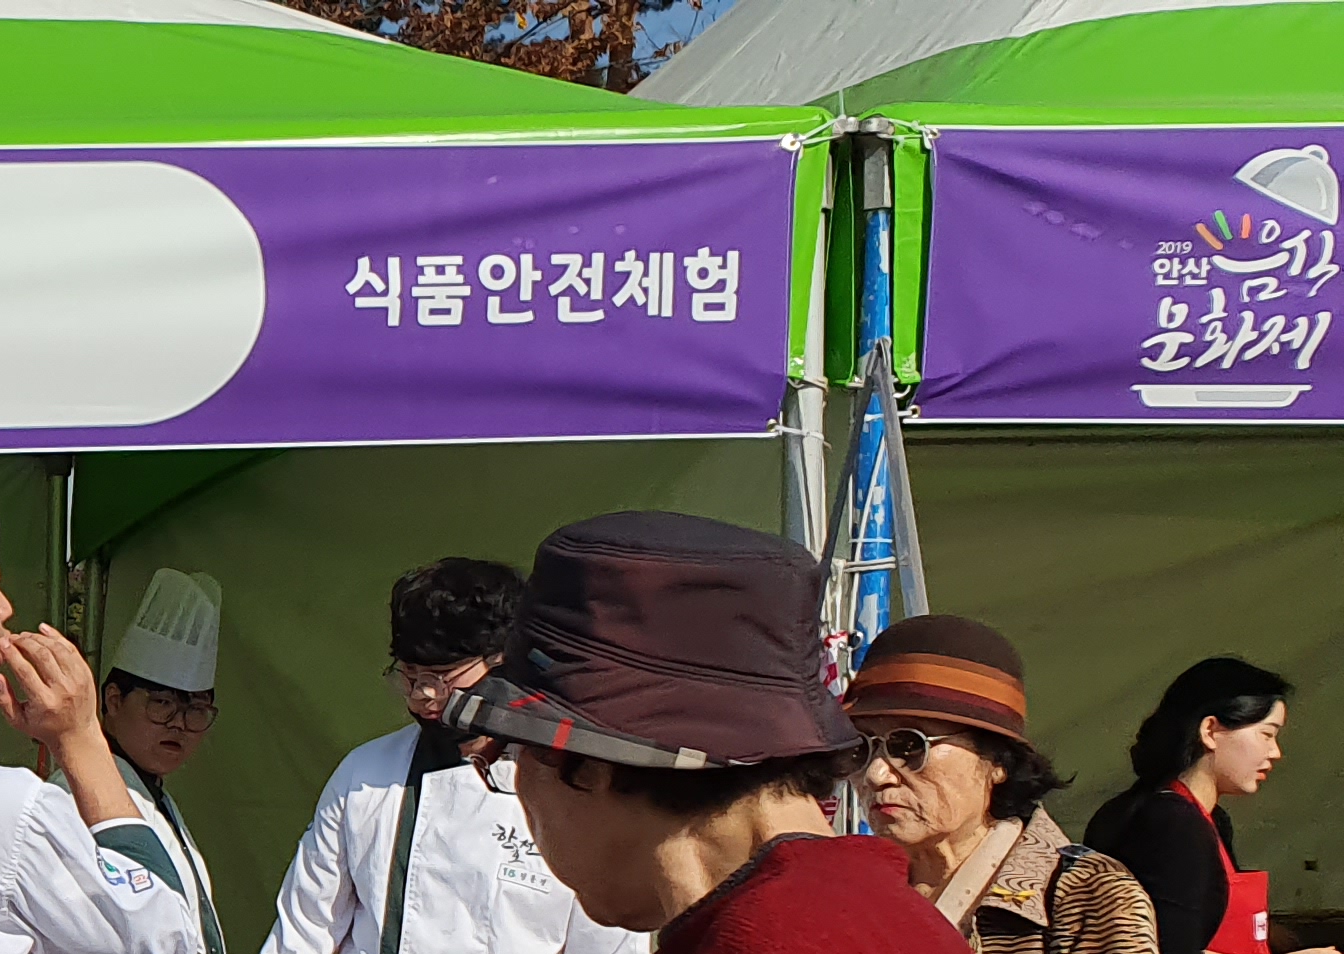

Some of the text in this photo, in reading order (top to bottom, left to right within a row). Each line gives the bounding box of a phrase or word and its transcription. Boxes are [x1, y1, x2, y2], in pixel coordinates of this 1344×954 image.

[1153, 257, 1211, 285] 안산
[1155, 241, 1193, 254] 2019
[345, 246, 740, 327] 식품안전체험
[1140, 287, 1332, 372] 문화제
